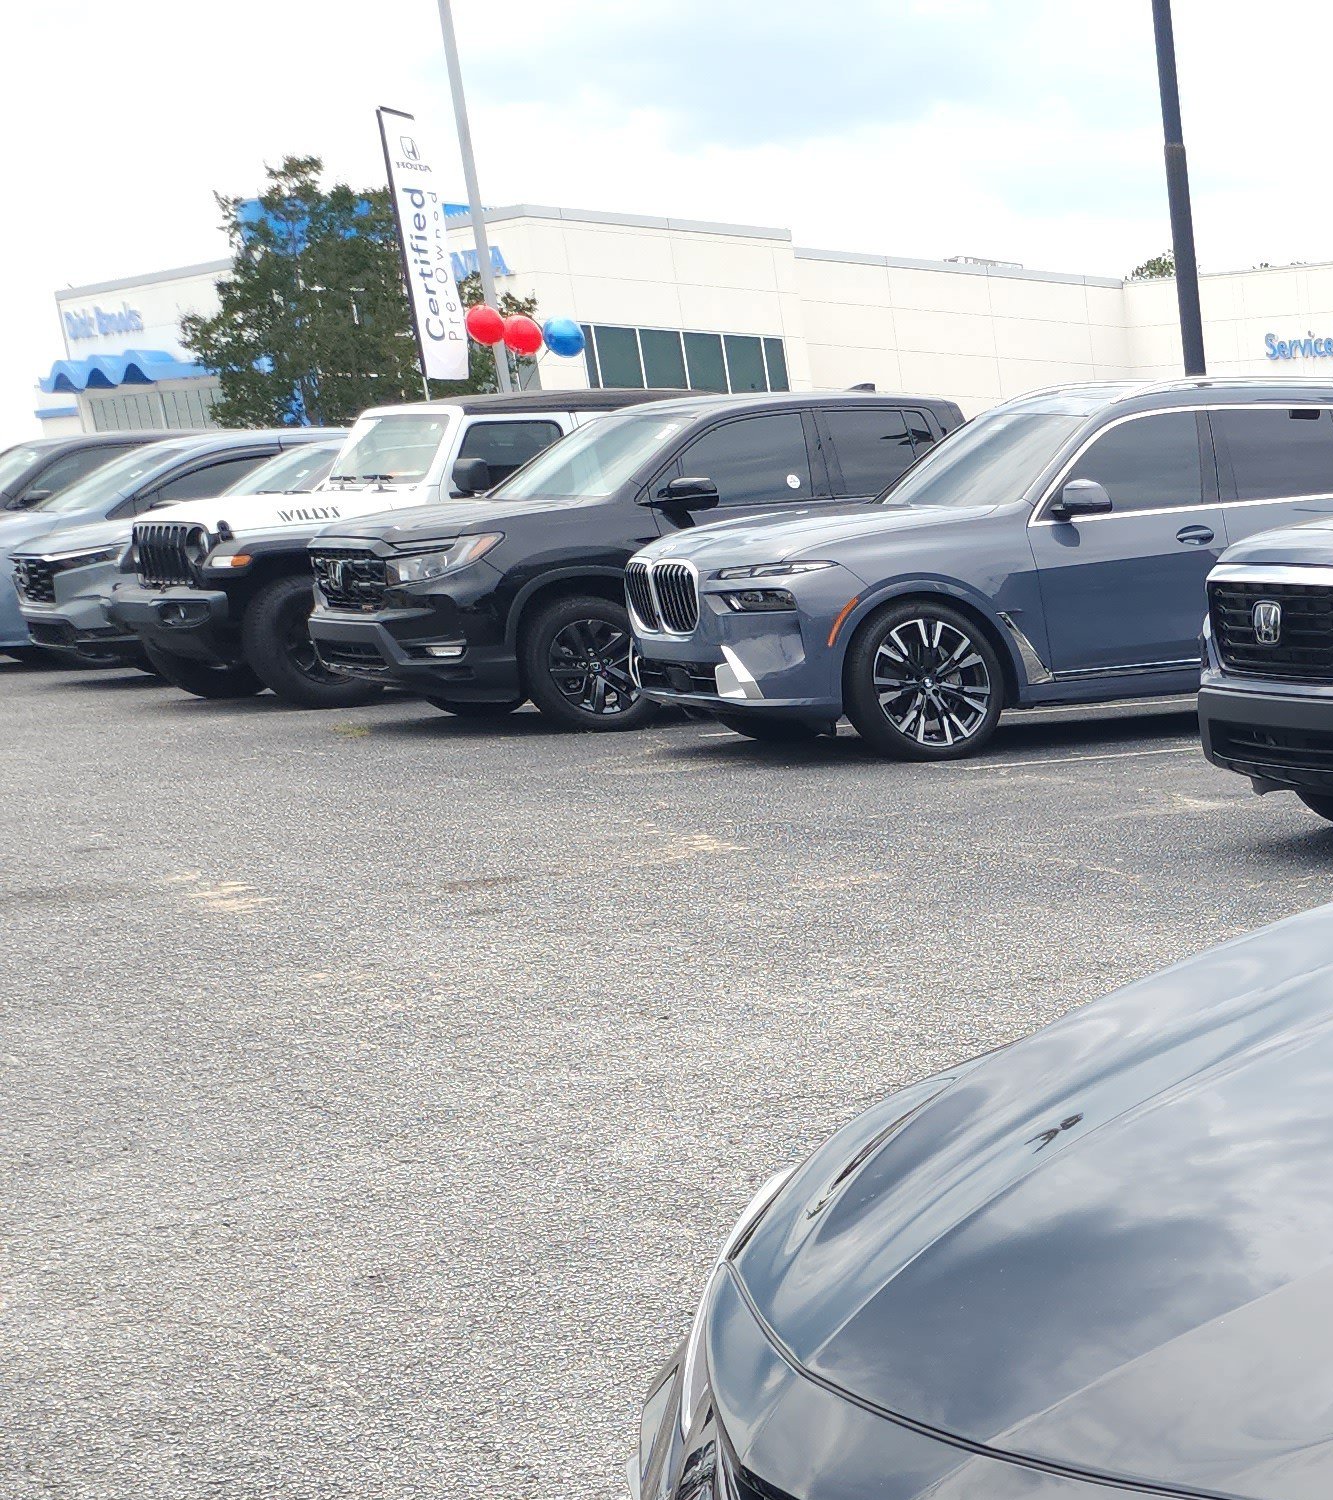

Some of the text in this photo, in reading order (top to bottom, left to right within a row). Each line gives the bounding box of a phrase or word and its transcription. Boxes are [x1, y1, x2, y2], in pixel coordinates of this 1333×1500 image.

[395, 161, 433, 172] HONDA
[402, 187, 446, 341] Certified
[427, 192, 464, 341] Pre-Owned
[277, 506, 341, 522] WILLYS
